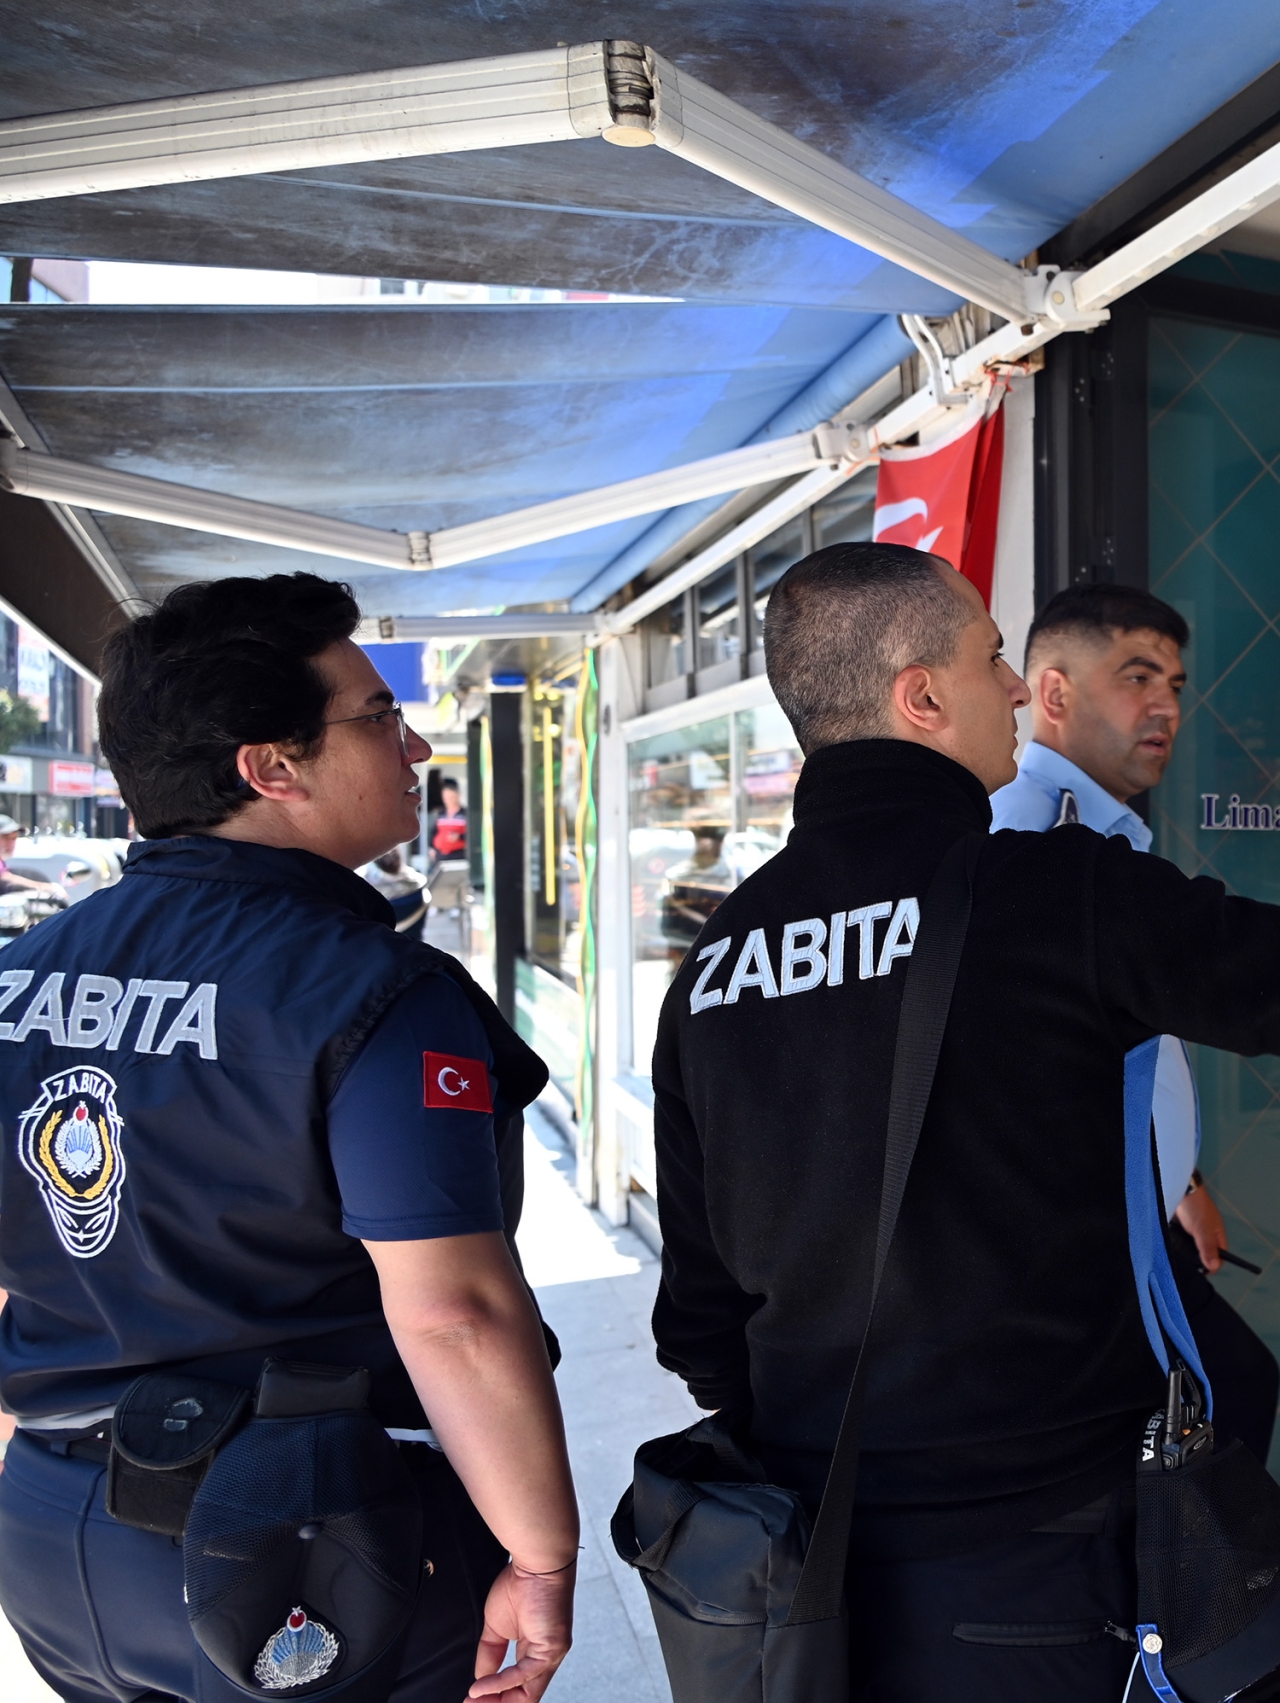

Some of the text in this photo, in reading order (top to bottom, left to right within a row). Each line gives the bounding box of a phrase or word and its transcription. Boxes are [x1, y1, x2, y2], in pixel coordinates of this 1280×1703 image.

[690, 896, 921, 1015] ZABITA
[0, 968, 218, 1060] ZABITA
[52, 1072, 107, 1104] ZABITA
